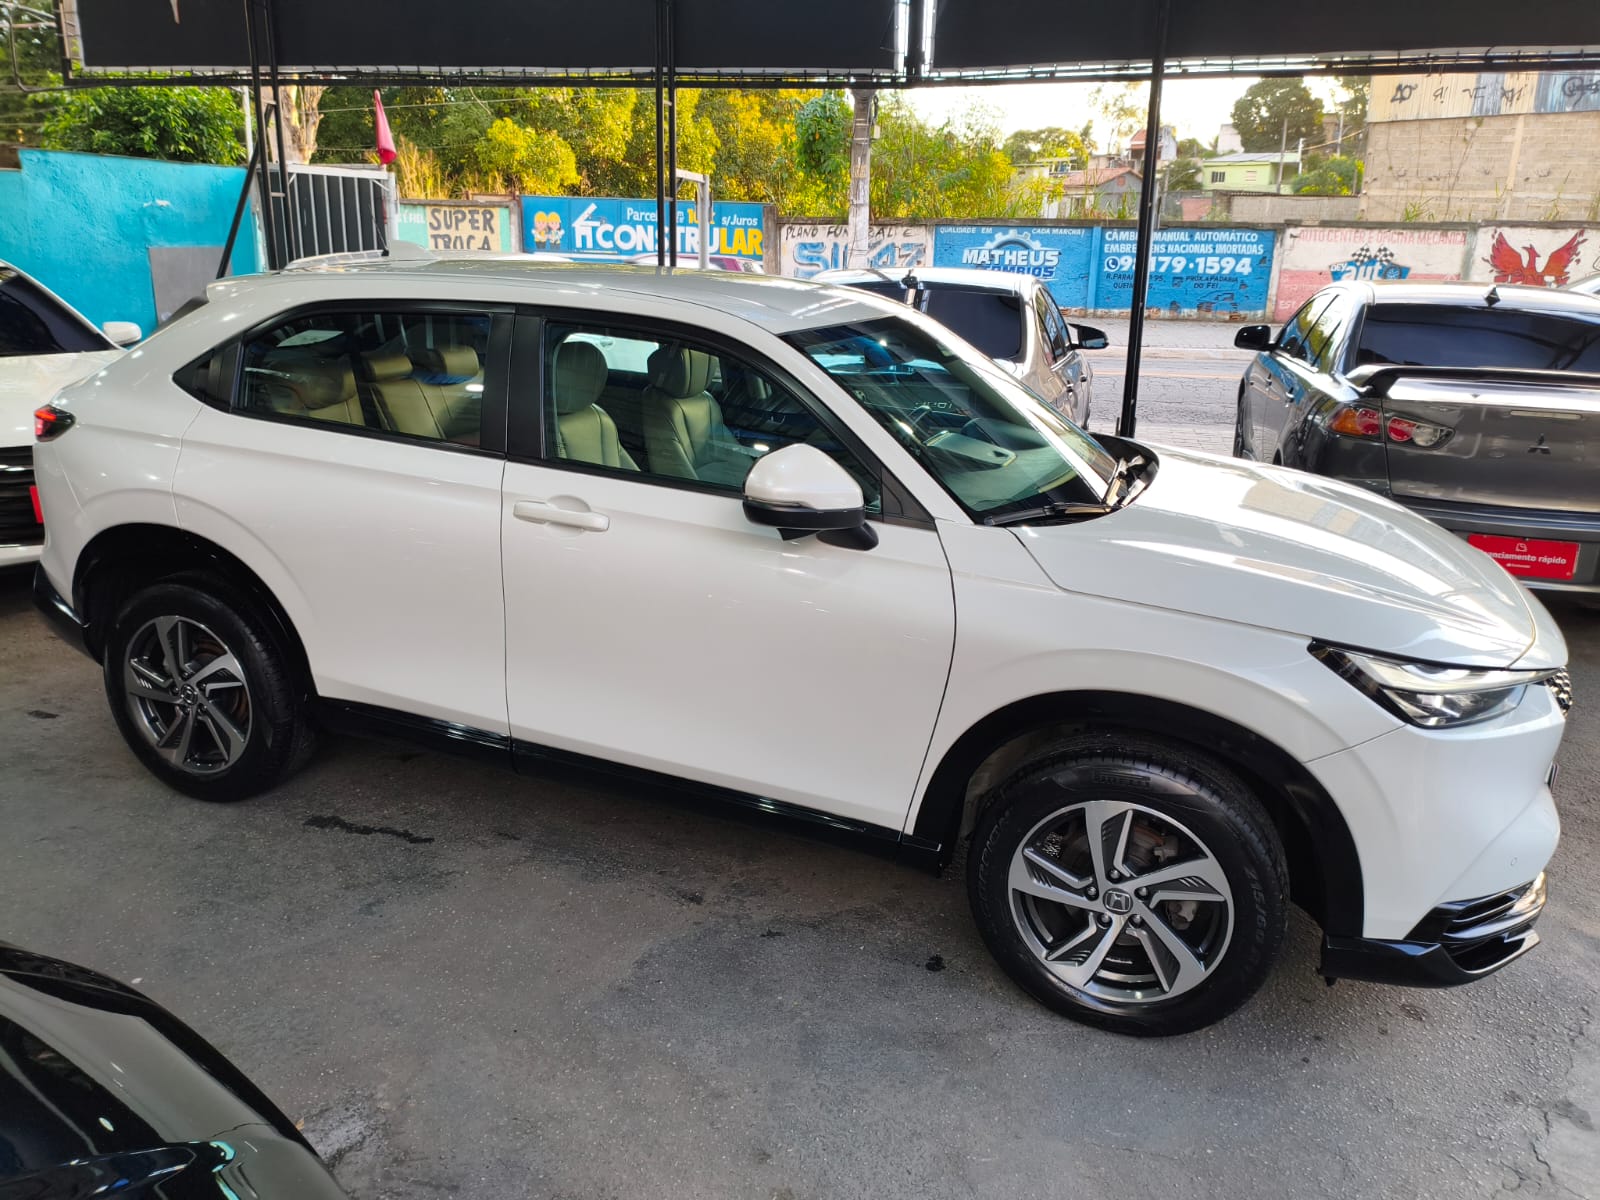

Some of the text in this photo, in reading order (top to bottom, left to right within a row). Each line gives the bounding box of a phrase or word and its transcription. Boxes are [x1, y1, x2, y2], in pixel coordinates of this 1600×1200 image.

[429, 207, 495, 234] SUPER
[627, 208, 658, 222] Parcel
[961, 249, 1060, 267] MATHEUS
[1538, 555, 1567, 566] rápido
